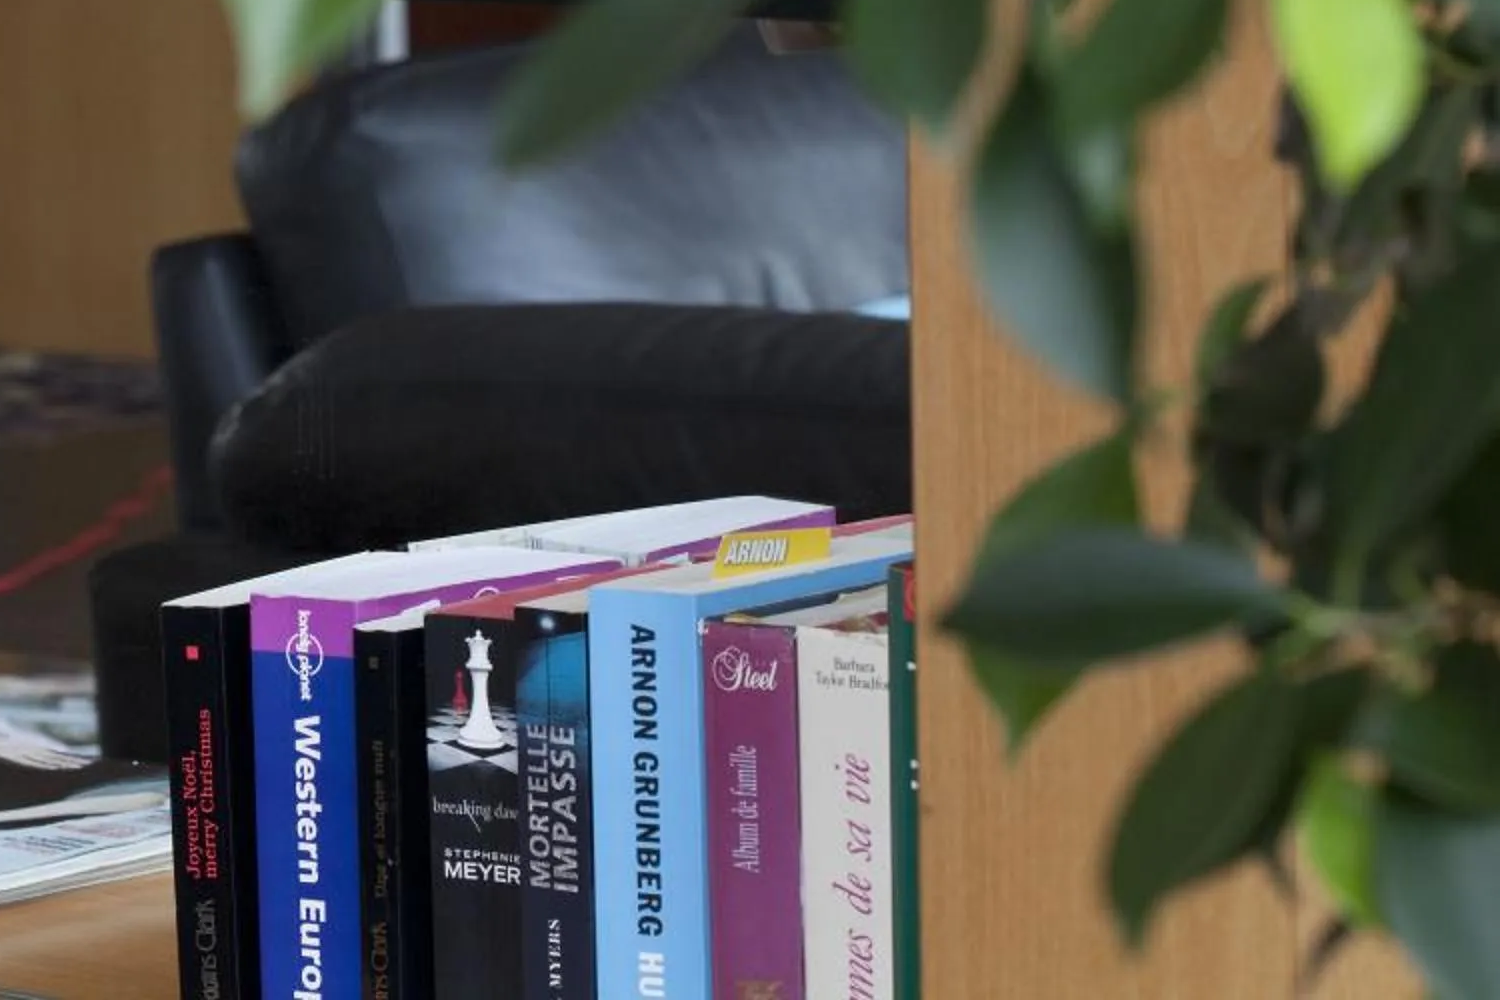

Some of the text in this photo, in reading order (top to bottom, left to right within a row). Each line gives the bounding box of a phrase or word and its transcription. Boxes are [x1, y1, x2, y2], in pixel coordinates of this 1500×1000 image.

[723, 536, 789, 566] ARNON
[630, 624, 658, 741] ARNON
[713, 645, 778, 692] Steel
[833, 657, 876, 674] Barbara
[181, 750, 204, 879] Joyeux Noël,
[199, 709, 220, 879] merry Christmas
[294, 715, 322, 884] Western
[433, 796, 519, 822] breaking daw
[527, 723, 551, 889] MORTELLE
[550, 727, 579, 893] IMPASSE
[633, 751, 663, 938] GRUNBERG
[728, 744, 760, 873] Album de famille
[832, 753, 875, 916] de sa vie
[444, 861, 521, 885] MEYER
[548, 918, 561, 988] MYERS
